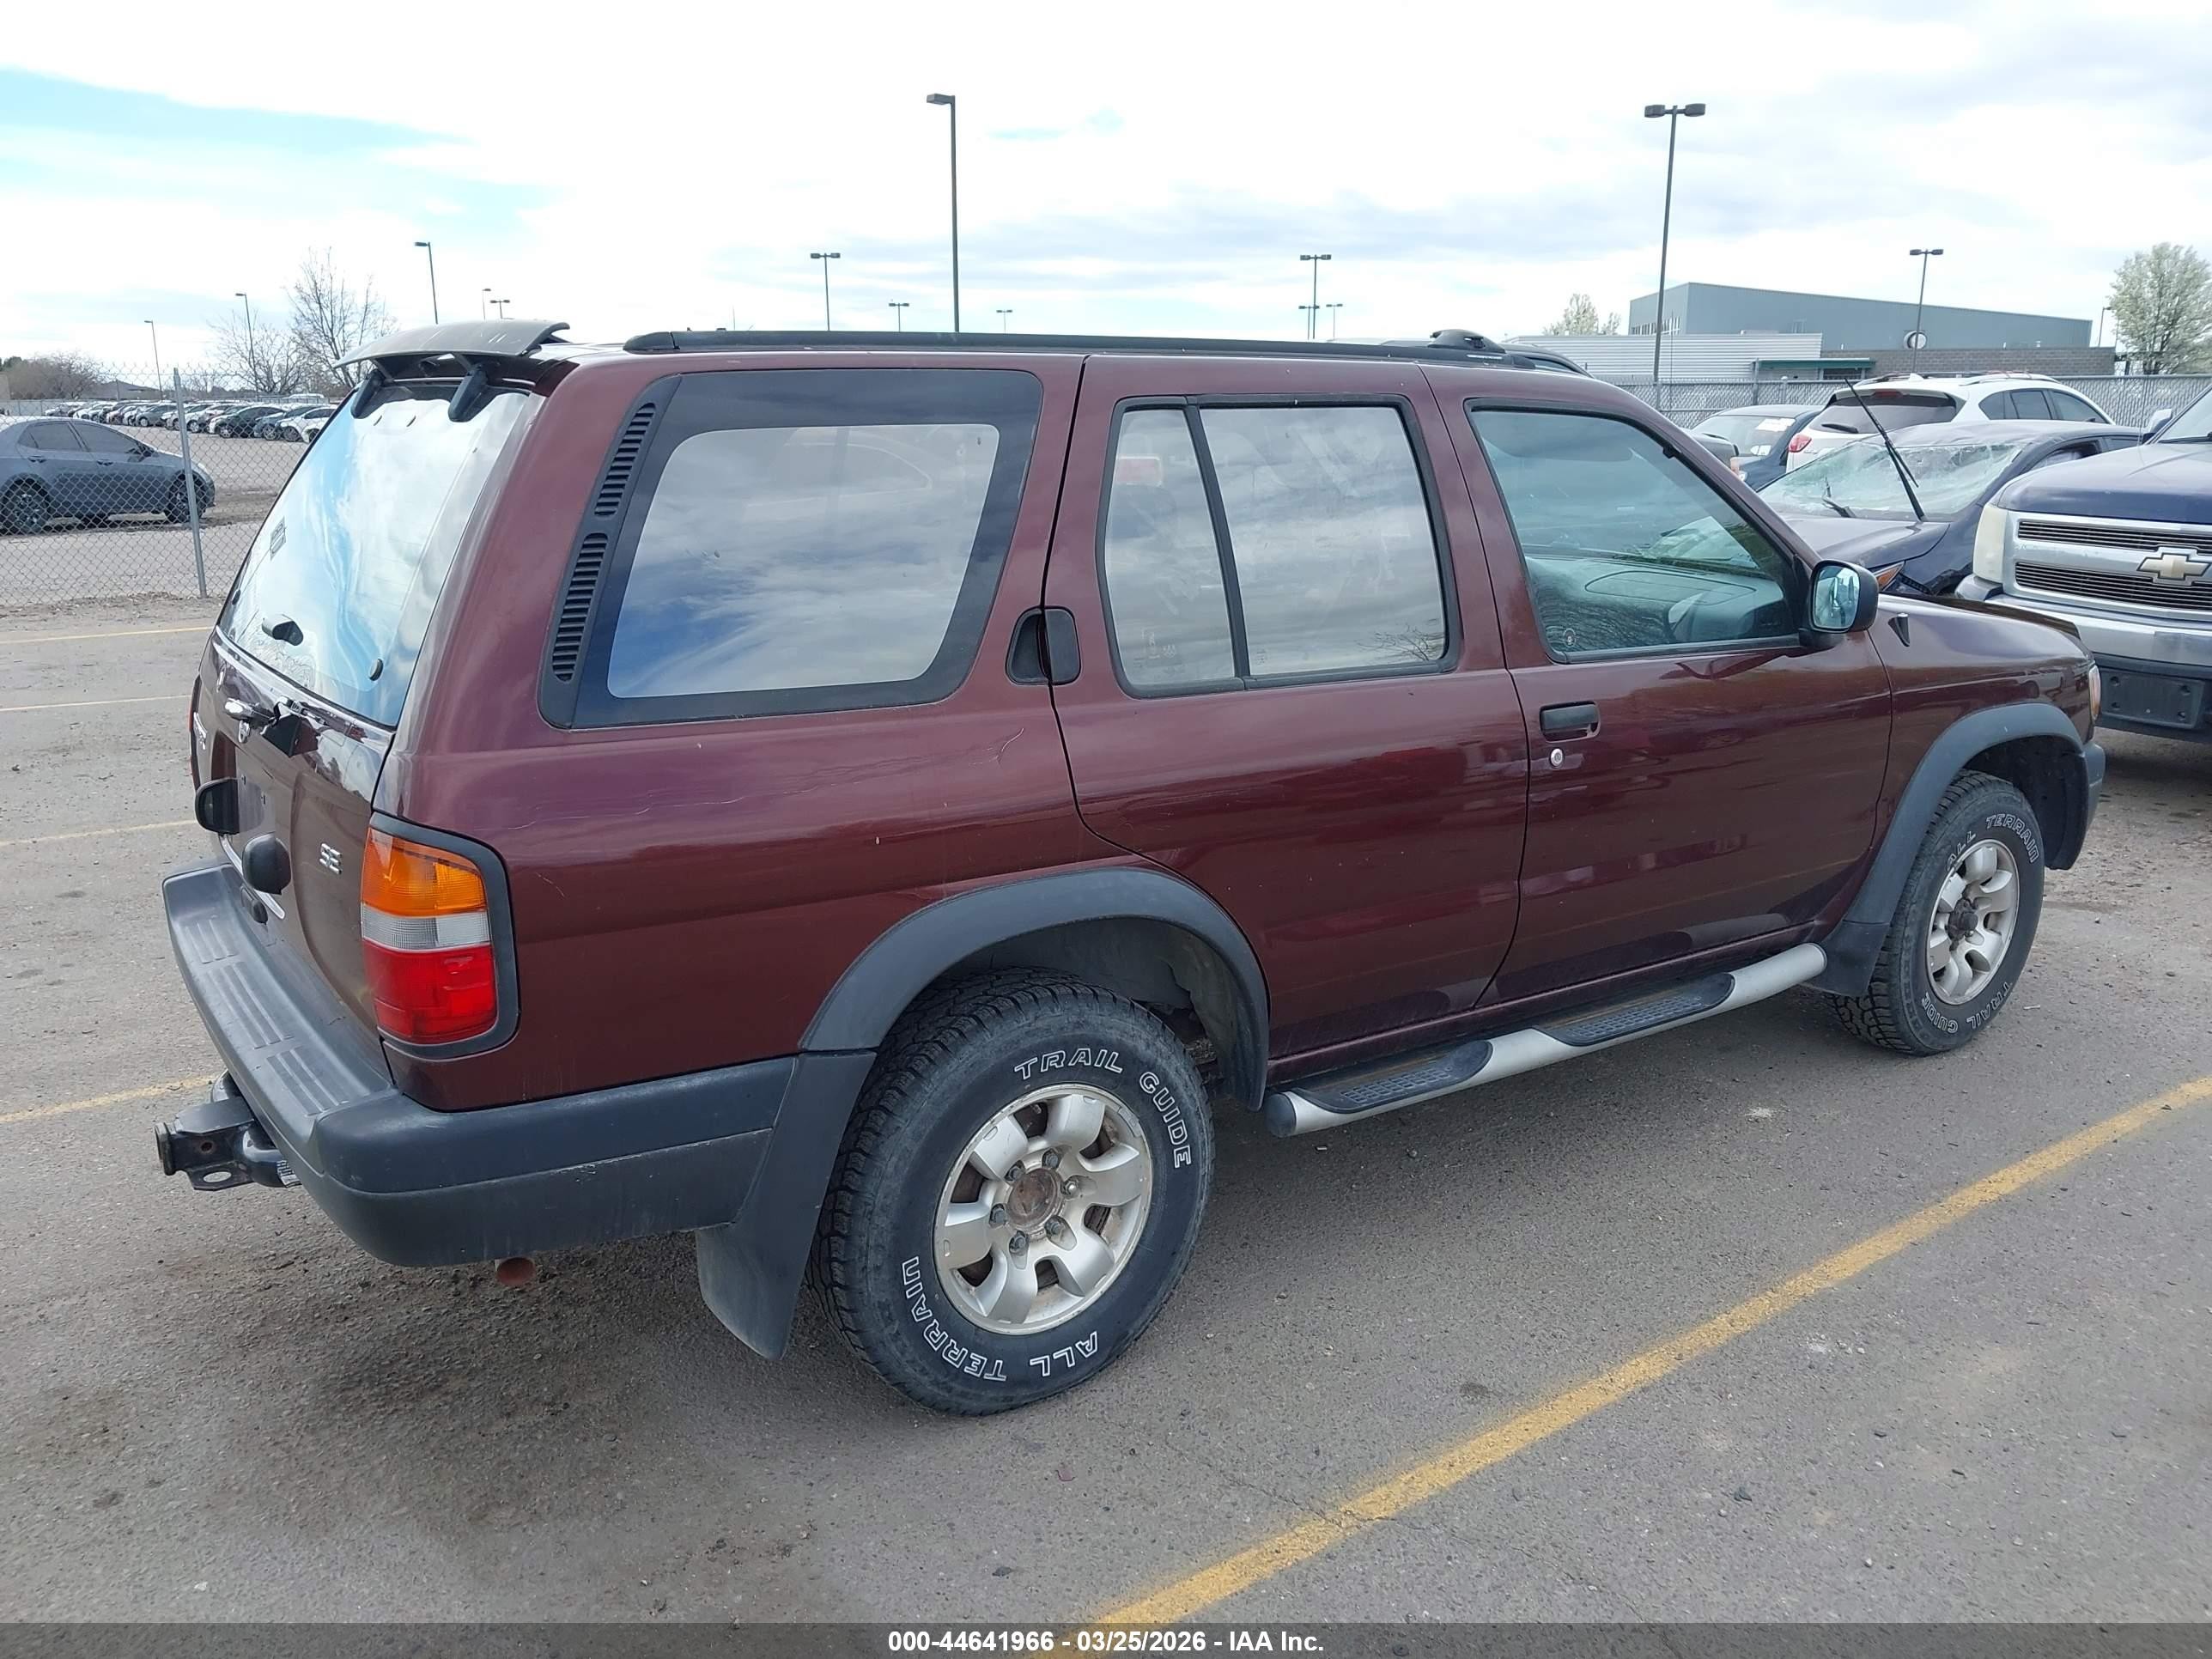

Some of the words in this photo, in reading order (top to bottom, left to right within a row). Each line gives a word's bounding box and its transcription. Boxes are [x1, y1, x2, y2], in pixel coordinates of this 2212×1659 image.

[1985, 813, 2040, 864] TERRAIN
[1921, 992, 1959, 1034] GUIDE
[1966, 981, 2011, 1030] TRAIL
[1014, 1048, 1123, 1080] TRAIL
[1139, 1071, 1192, 1169] GUIDE
[902, 1256, 1007, 1382] TERRAIN
[1030, 1331, 1098, 1376] ALL
